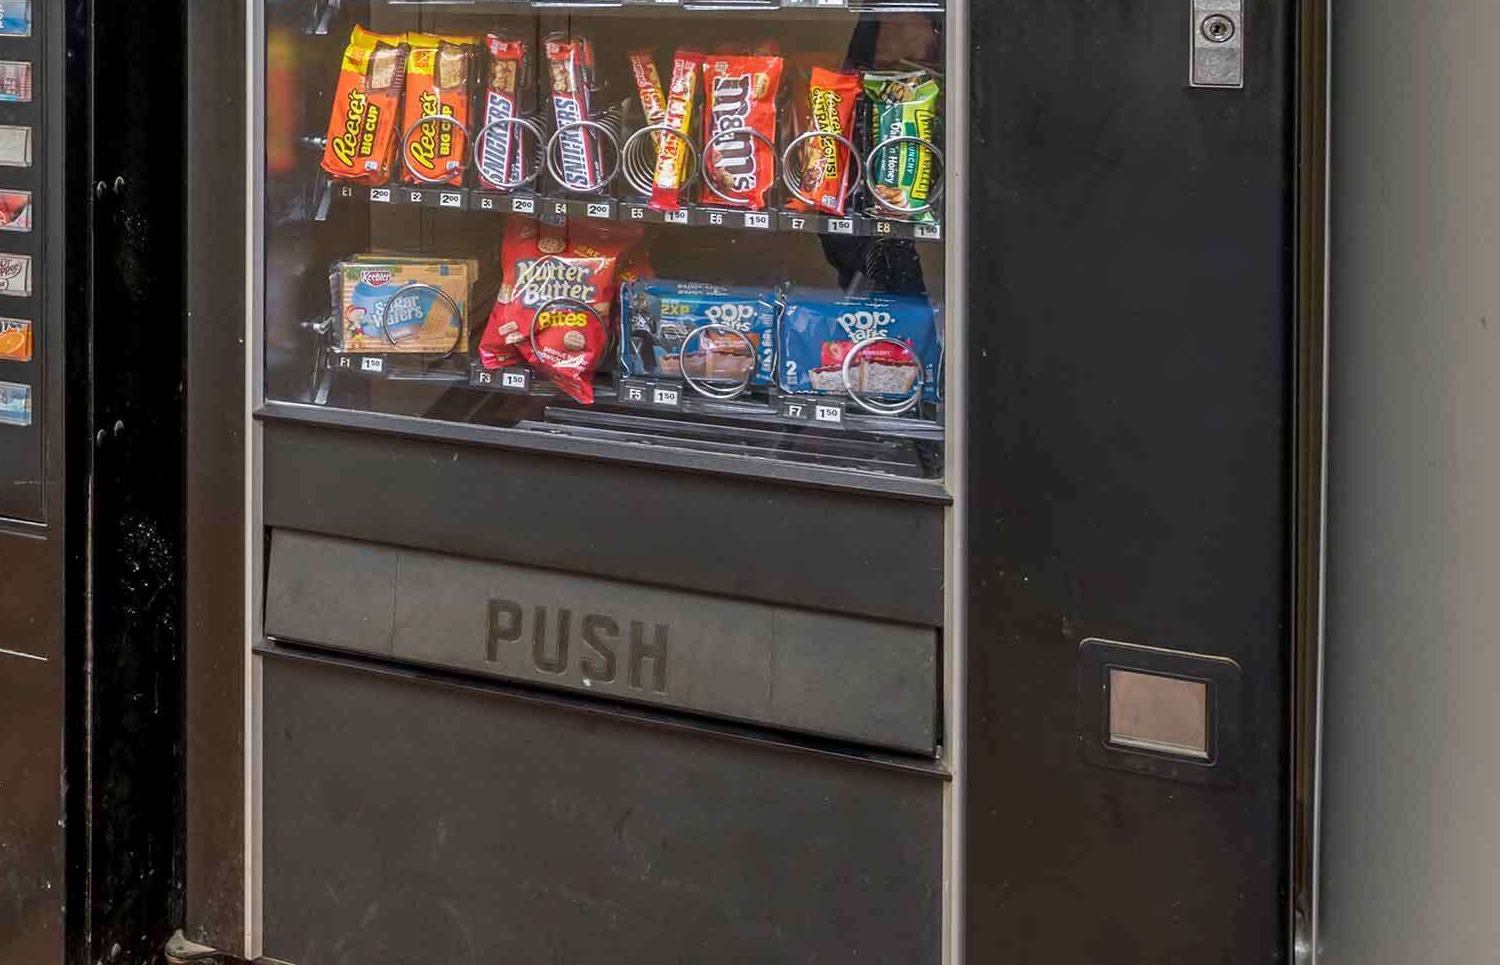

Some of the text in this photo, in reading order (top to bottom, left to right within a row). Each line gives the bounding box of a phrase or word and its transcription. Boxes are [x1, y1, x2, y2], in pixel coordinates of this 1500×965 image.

[332, 89, 366, 167] Reese's
[360, 106, 380, 156] BIG CUP
[410, 92, 438, 170] Reese's
[482, 93, 512, 185] SNICKERS
[440, 132, 451, 156] BIG
[885, 156, 898, 184] Honey
[517, 261, 589, 284] Nutter
[524, 280, 594, 304] Butter
[539, 309, 588, 328] Bites
[629, 389, 641, 399] F5
[789, 406, 802, 416] F7
[483, 596, 670, 695] PUSH
